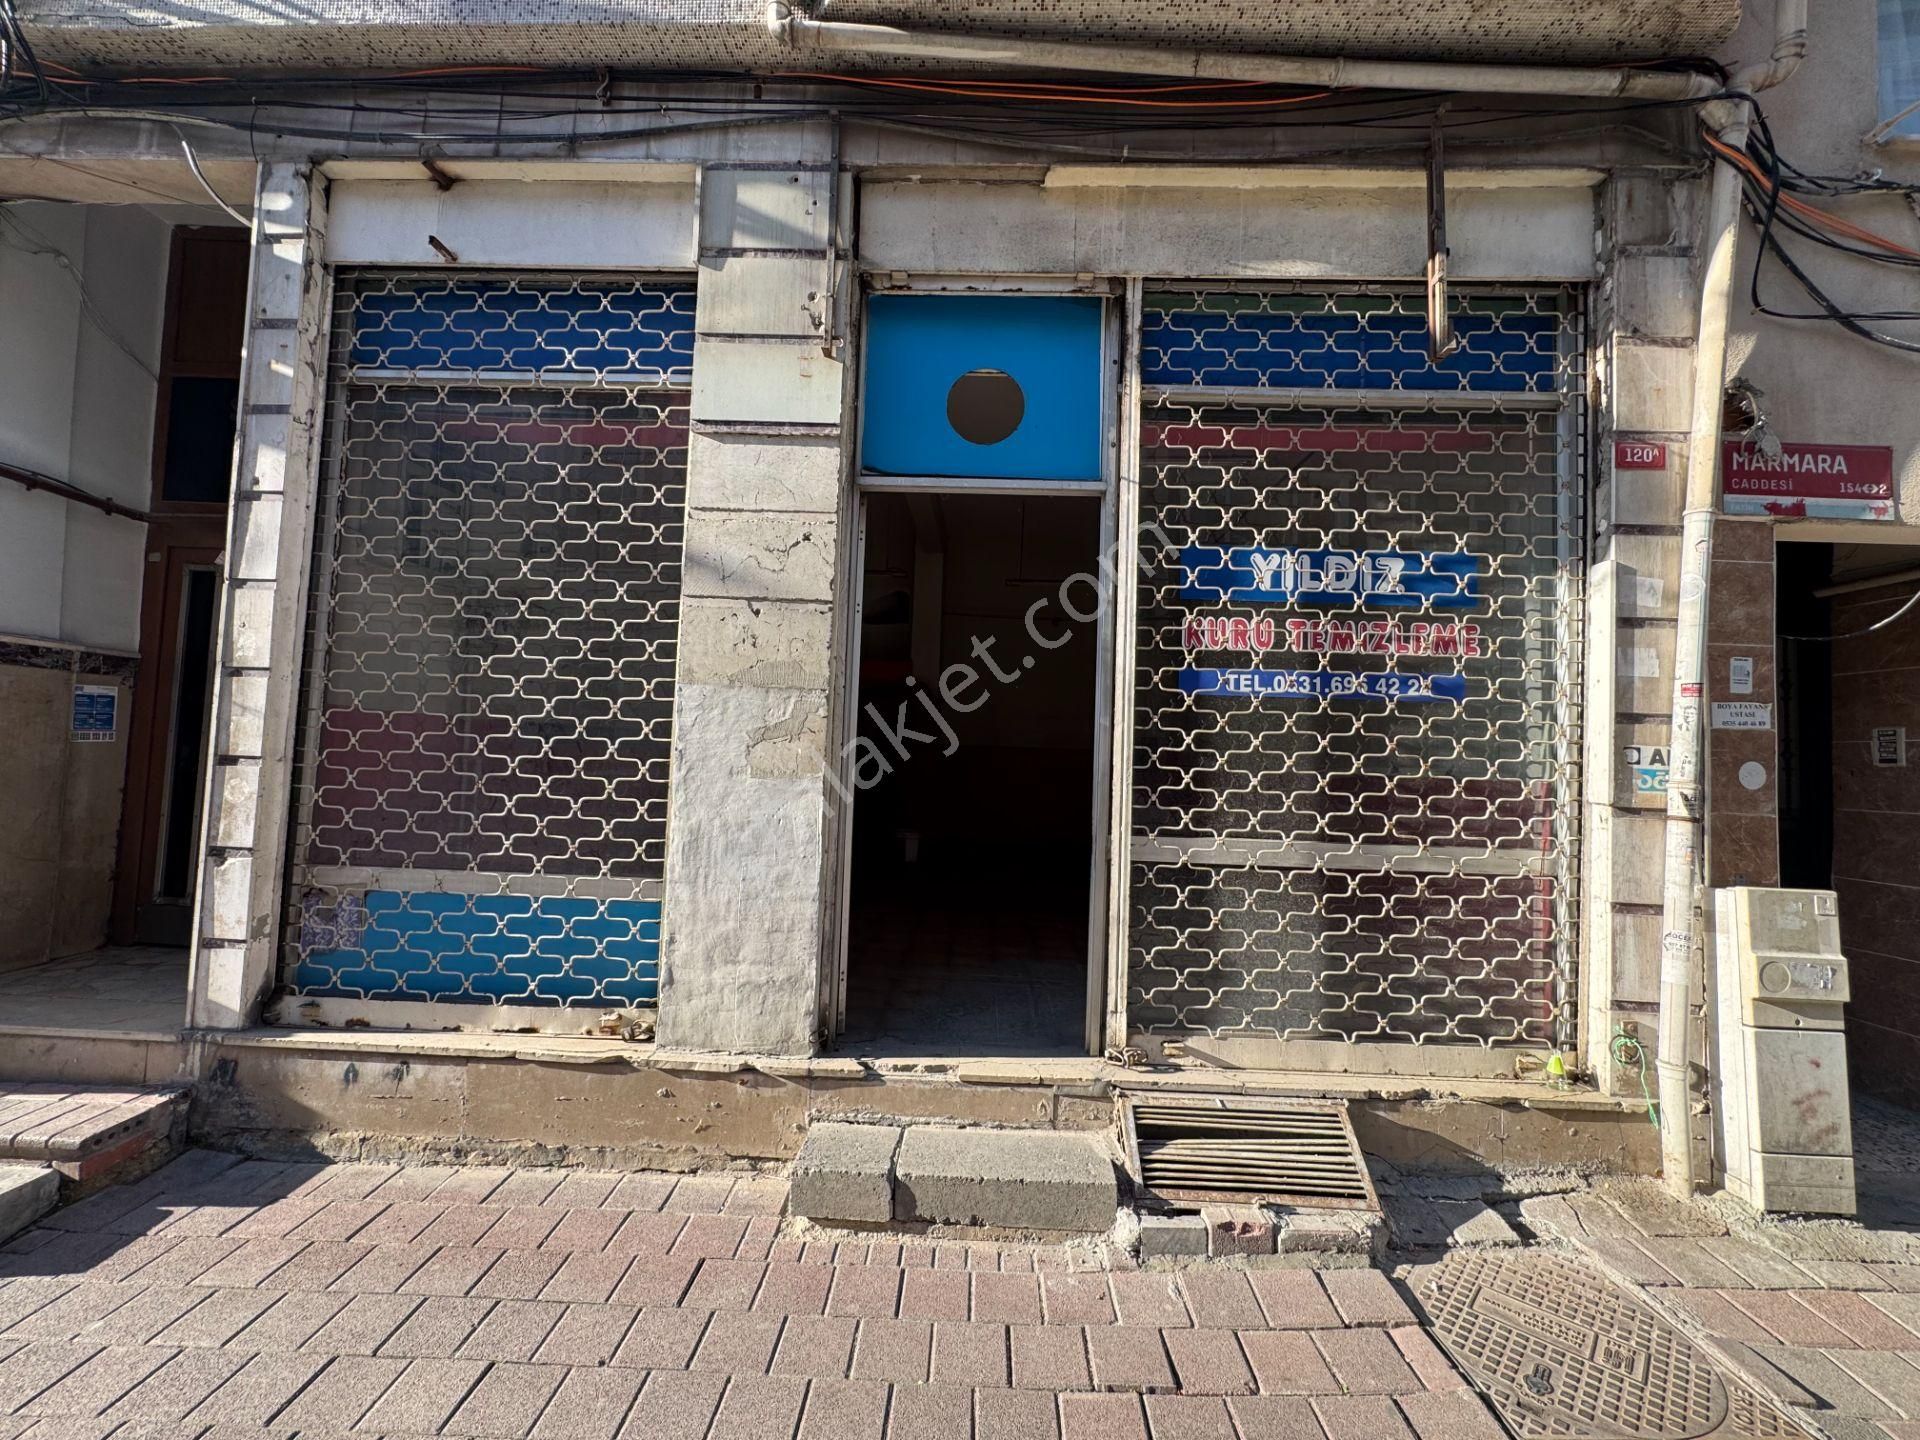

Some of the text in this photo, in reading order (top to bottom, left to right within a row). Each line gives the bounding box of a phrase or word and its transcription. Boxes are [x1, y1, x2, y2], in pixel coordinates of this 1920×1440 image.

[1732, 451, 1848, 475] MARMARA
[1731, 477, 1793, 490] CADDESİ
[1250, 552, 1405, 593] YILDIZ
[1181, 616, 1275, 651] KURU
